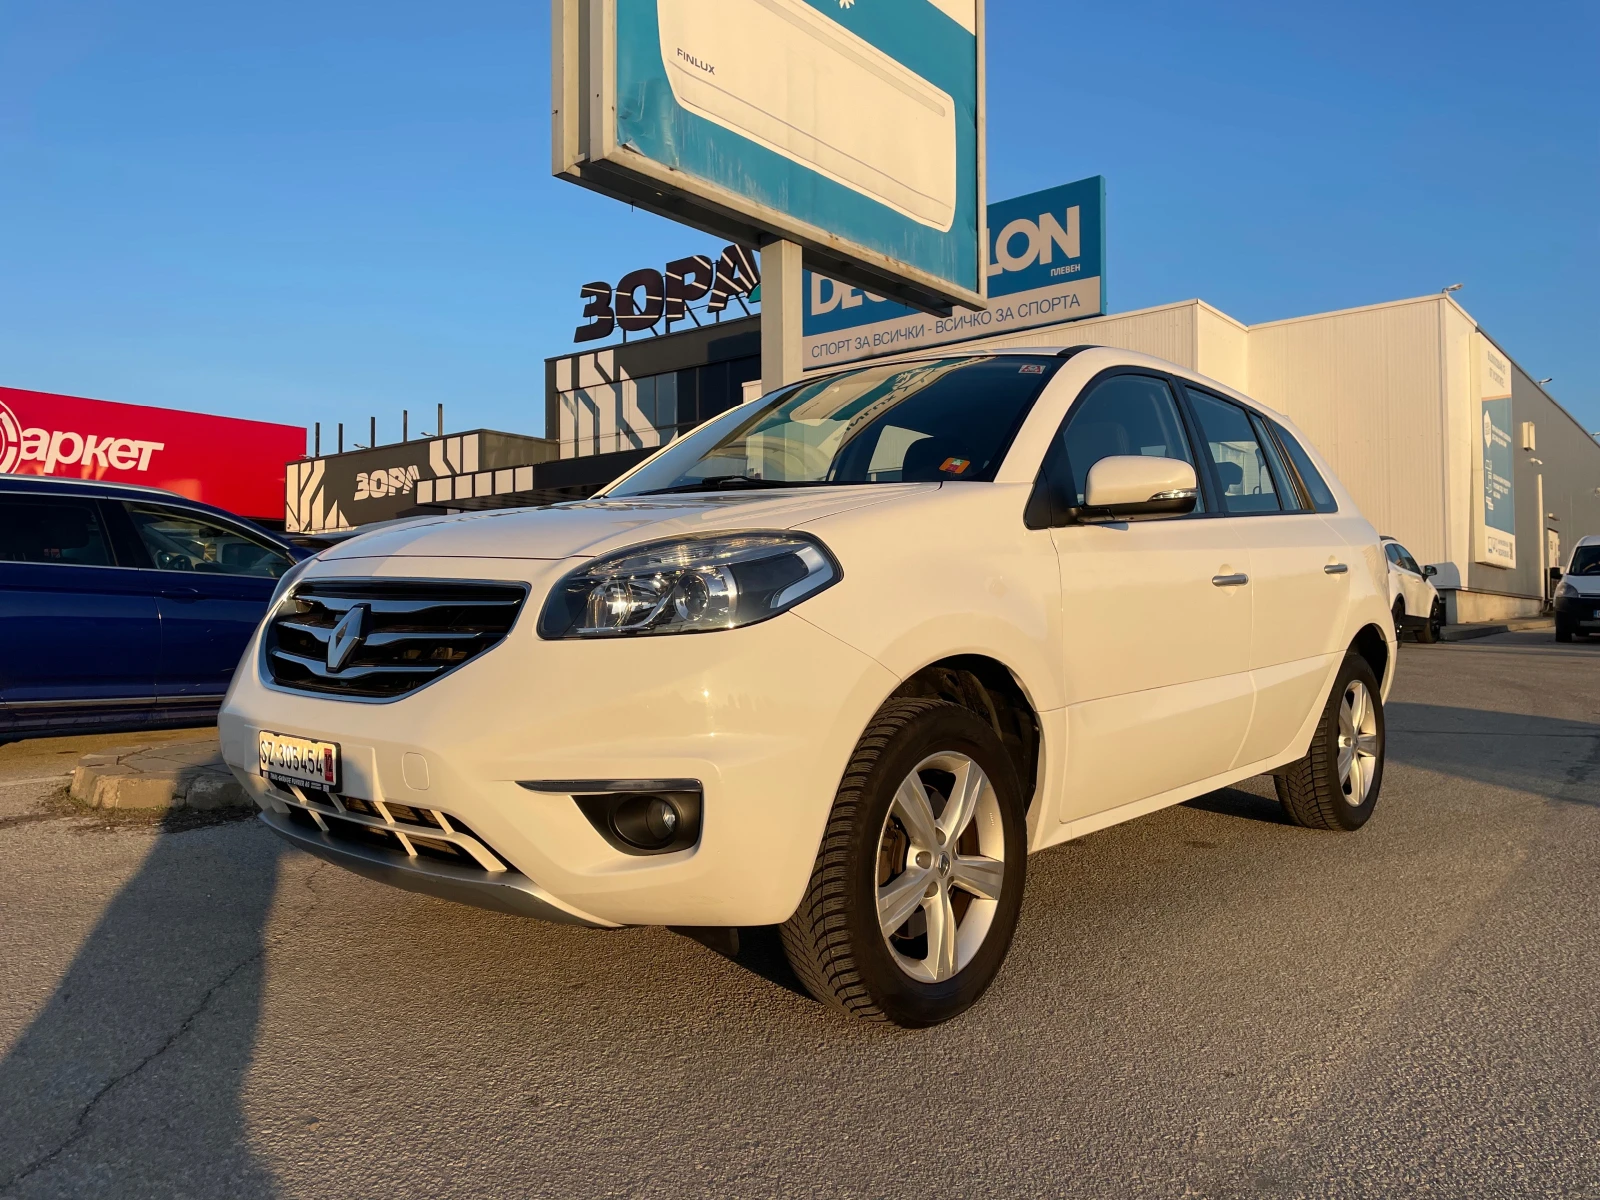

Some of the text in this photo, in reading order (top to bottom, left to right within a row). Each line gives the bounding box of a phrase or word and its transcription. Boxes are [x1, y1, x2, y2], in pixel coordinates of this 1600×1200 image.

[676, 47, 715, 76] FINLUX
[573, 243, 761, 343] ЗОРА
[1051, 263, 1081, 277] ПЛЕВЕН
[811, 338, 852, 358] СПОРТ
[854, 335, 870, 350] ЗА
[873, 324, 925, 347] ВСИЧКИ
[935, 312, 992, 334] ВСИЧКО
[996, 307, 1014, 322] ЗА
[1018, 293, 1081, 318] СПОРТА
